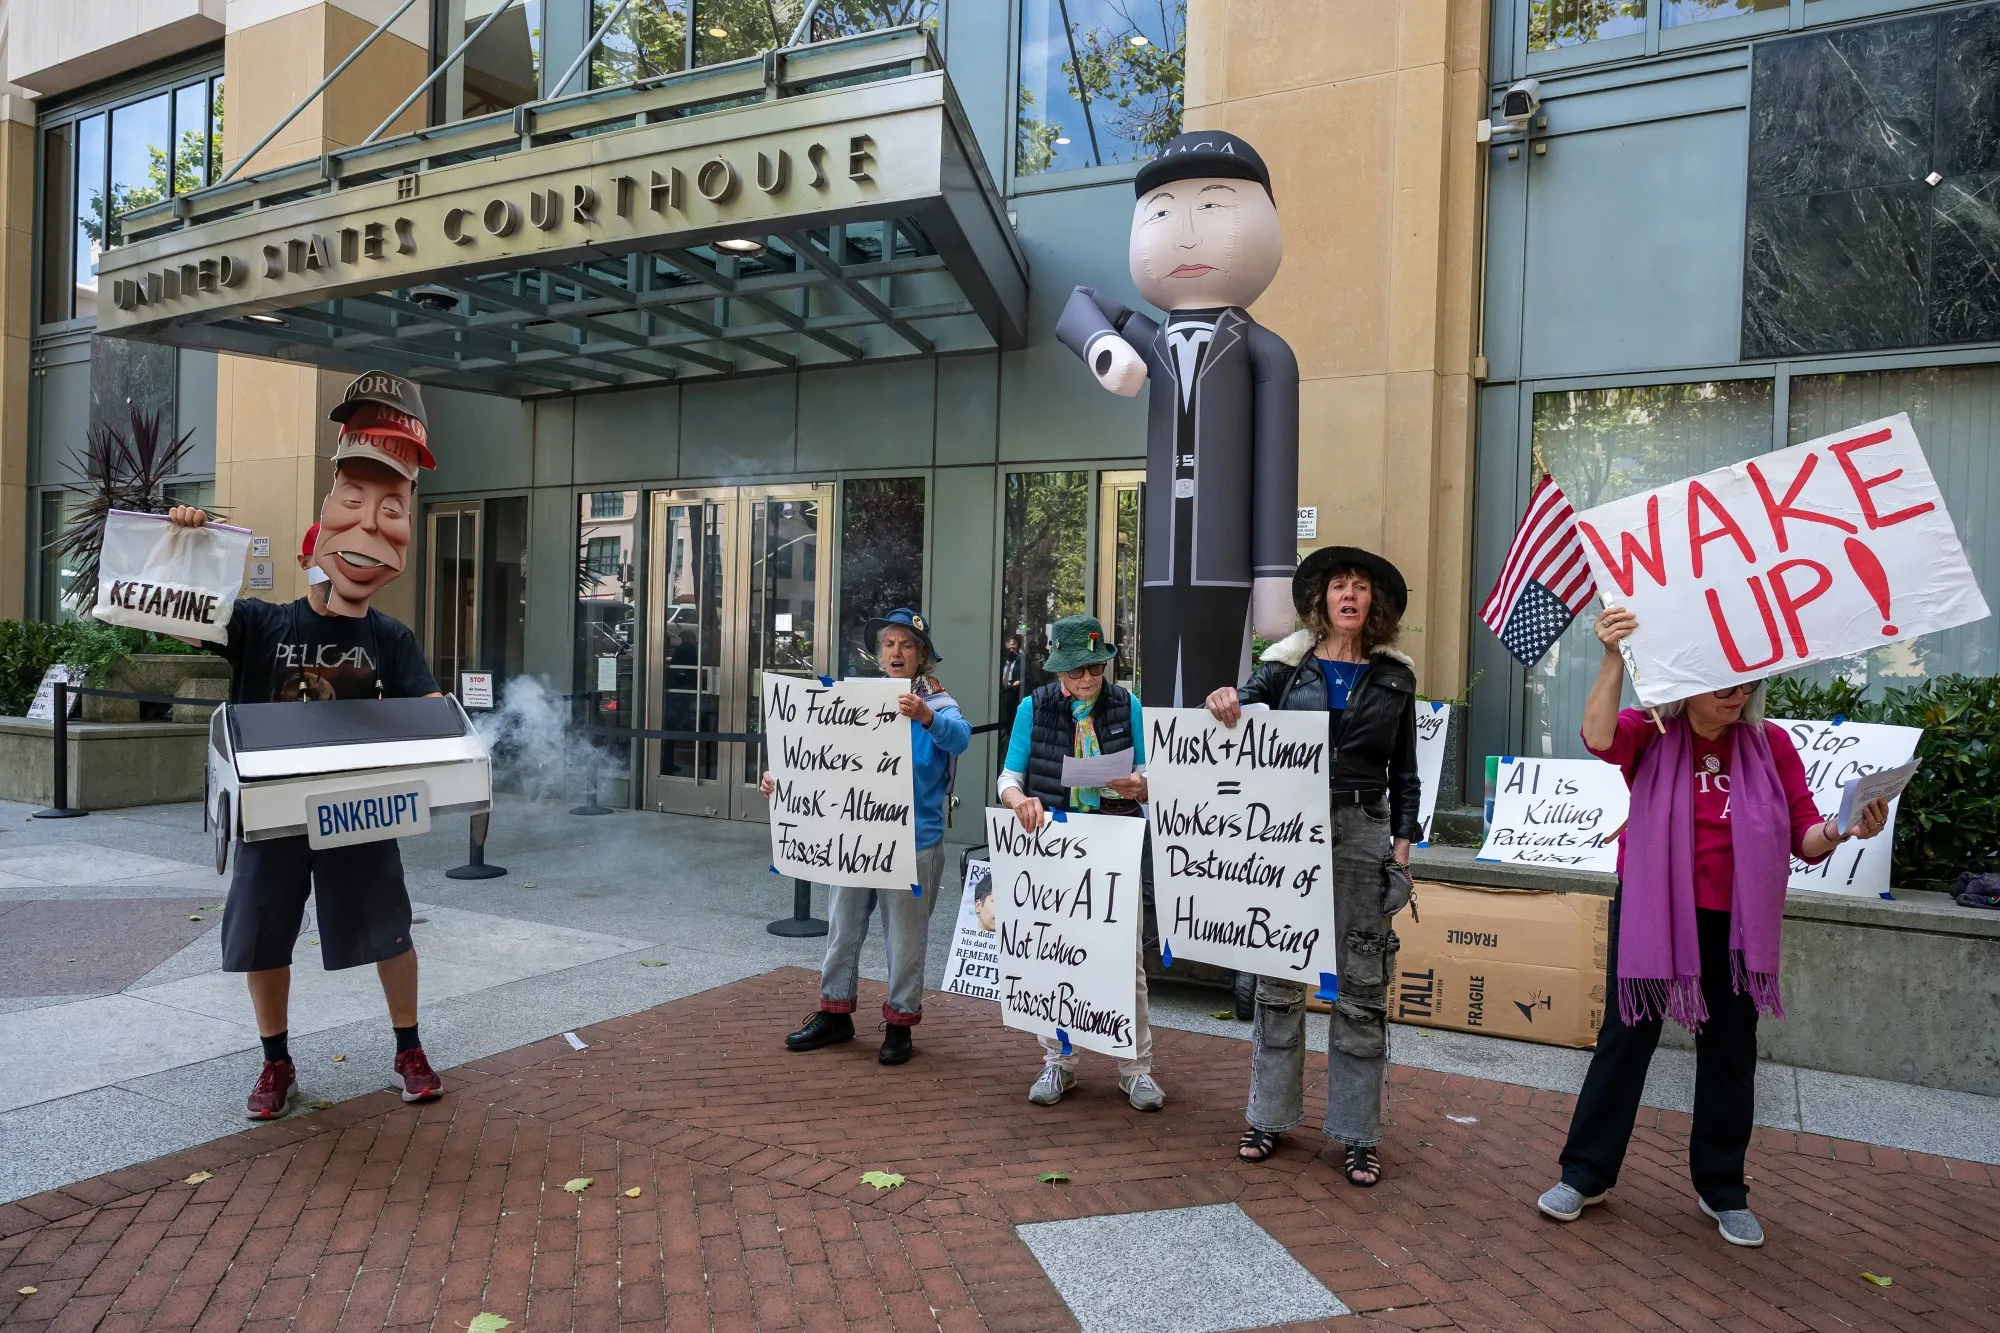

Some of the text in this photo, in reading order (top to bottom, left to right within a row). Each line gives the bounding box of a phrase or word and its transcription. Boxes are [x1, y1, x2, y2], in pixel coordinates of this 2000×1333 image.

[113, 133, 873, 310] UNITED STATES COURTHOUSE
[347, 376, 404, 400] DORK
[1297, 509, 1314, 518] ICE
[1578, 428, 1935, 597] WAKE
[110, 580, 218, 624] KETAMINE
[1705, 536, 1898, 673] UP!
[275, 643, 376, 671] PELICAN
[768, 682, 901, 731] No Future for
[1416, 714, 1443, 740] cing
[1790, 724, 1860, 755] Stop
[876, 750, 902, 776] in
[1504, 762, 1579, 795] AI is
[317, 792, 419, 836] BNKRUPT
[840, 786, 909, 826] Altman
[1246, 802, 1304, 844] Death
[1523, 799, 1603, 830] Killing
[778, 822, 896, 874] Fascist World
[1493, 828, 1578, 846] Patients
[1165, 845, 1321, 897] Destruction of
[1512, 849, 1595, 864] Kaiser
[1013, 870, 1071, 913] Over
[960, 927, 996, 940] Sam didn
[961, 938, 973, 947] his
[973, 939, 987, 949] dad
[1000, 918, 1087, 966] Not Techno
[1447, 930, 1498, 948] FRAGILE
[955, 948, 998, 964] REMEMB
[955, 958, 999, 984] Jerry
[1005, 975, 1057, 1023] Fascist
[1399, 968, 1434, 1018] TALL
[1468, 975, 1485, 1026] FRAGILE
